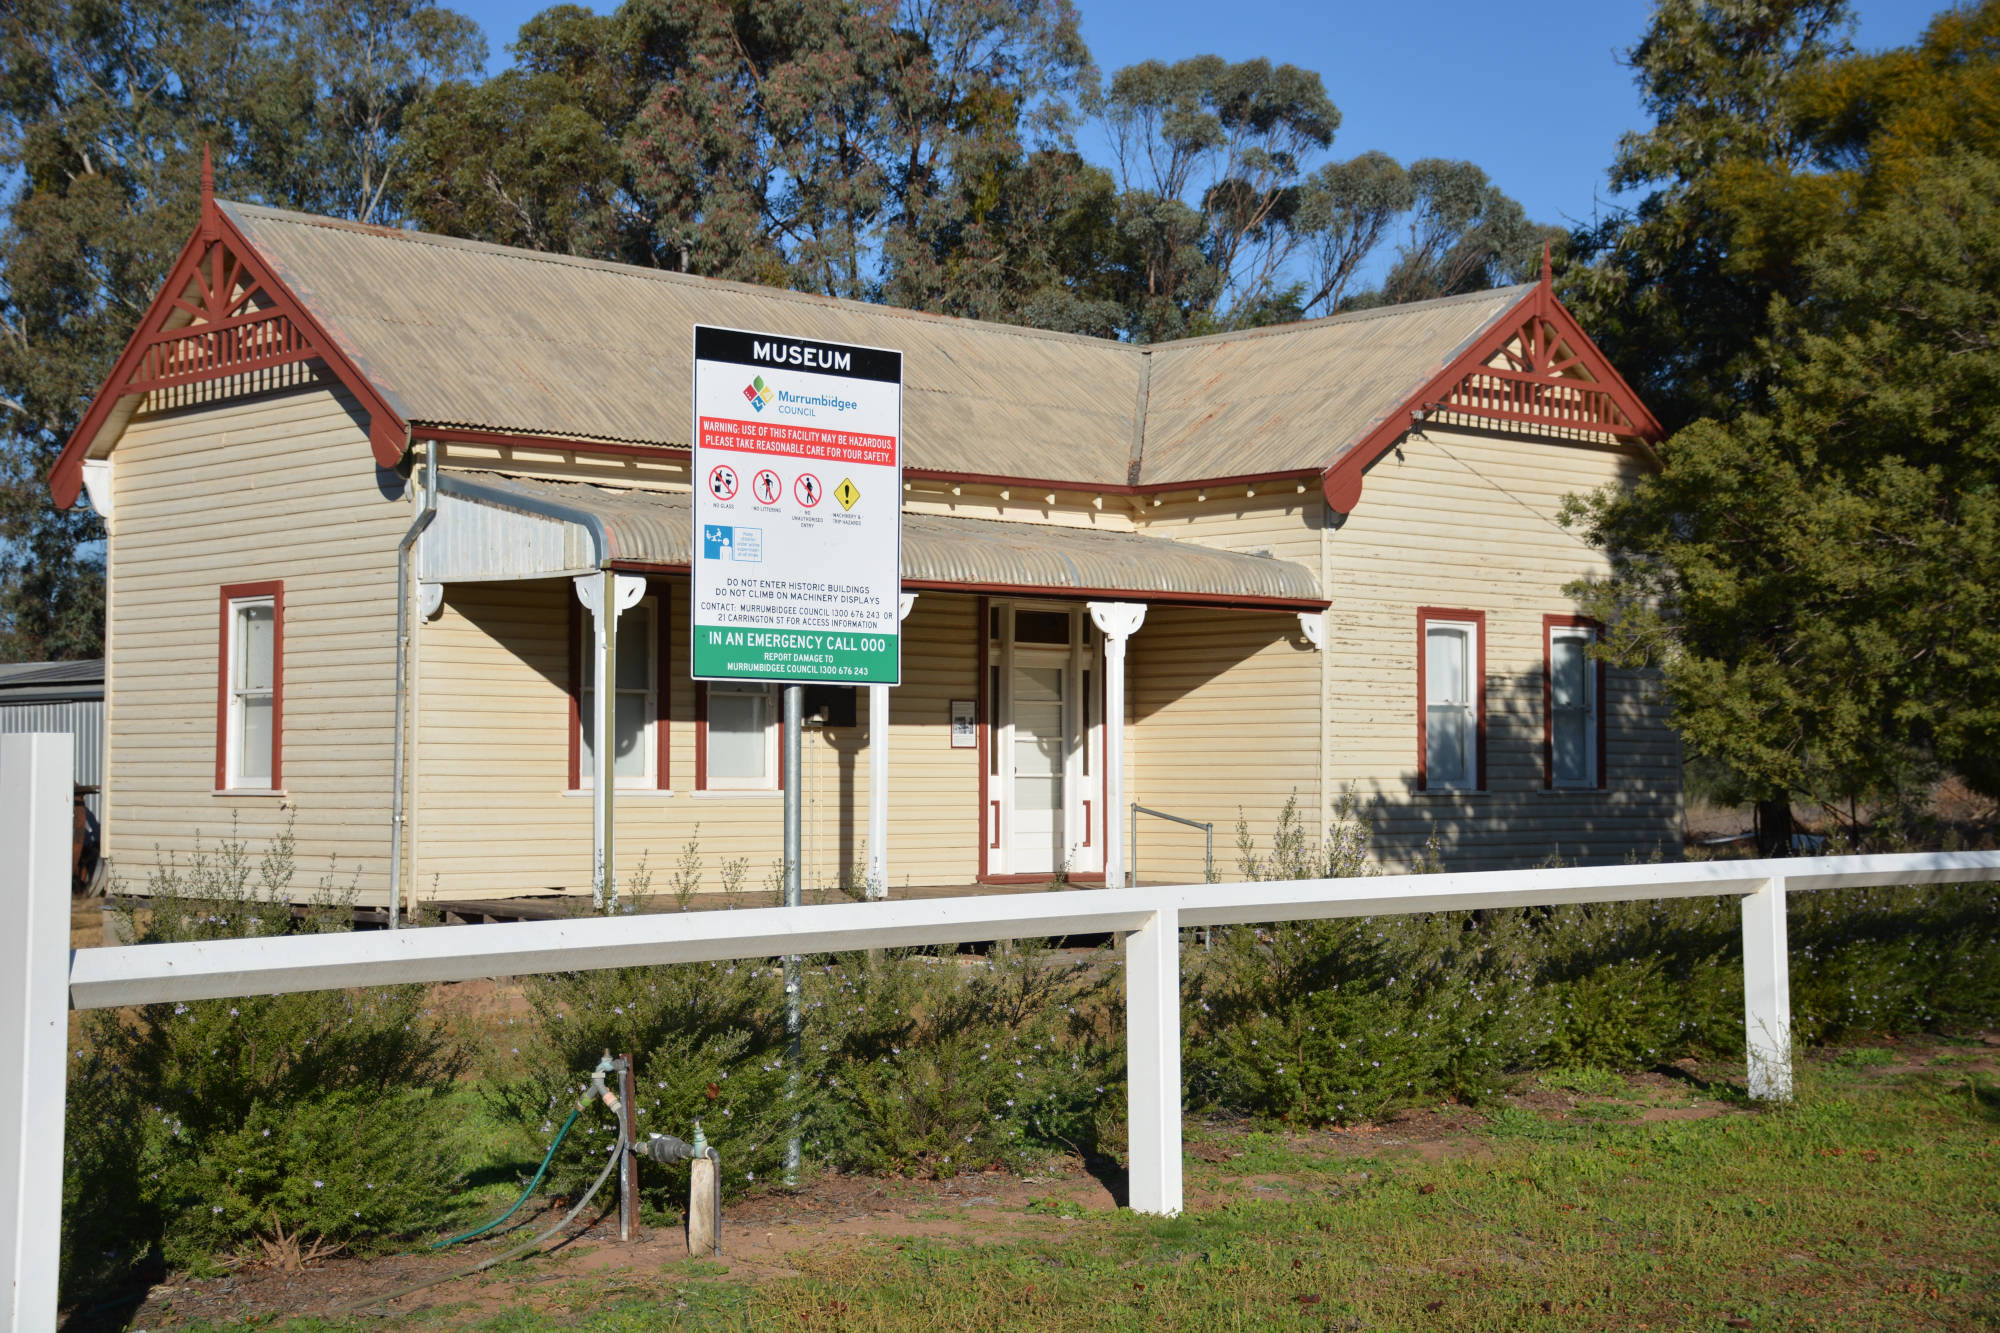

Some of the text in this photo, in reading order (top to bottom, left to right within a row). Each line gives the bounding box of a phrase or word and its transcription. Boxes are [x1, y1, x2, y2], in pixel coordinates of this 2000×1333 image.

[754, 340, 850, 370] MUSEUM
[778, 390, 857, 411] Murrumbidgee
[778, 405, 816, 416] COUNCIL
[704, 420, 893, 450] WARNING: USE OF THIS FACILITY MAY BE HAZARDOUS.
[706, 434, 892, 462] PLEASE TAKE REASONABLE CARE FOR YOUR SAFETY.
[727, 578, 870, 594] DO NOT ENTER HISTORIC BUILDINGS
[716, 588, 727, 596] DO
[748, 590, 774, 598] CLIMB
[776, 592, 788, 600] ON
[790, 592, 838, 602] MACHINERY
[840, 596, 880, 604] DISPLAYS
[740, 604, 798, 614] MURRUMBIDGEE
[798, 607, 830, 616] COUNCIL
[832, 610, 848, 618] 1300
[866, 611, 880, 619] 243
[718, 614, 726, 622] 21
[728, 614, 774, 624] CARRINGTON
[802, 618, 830, 626] ACCESS
[832, 620, 878, 628] INFORMATION
[709, 632, 886, 652] IN AN EMERGENCY CALL 000
[764, 652, 834, 663] REPORT DAMAGE TO
[727, 662, 868, 676] MURRUMBIDGEE COUNCIL 1300 676 243
